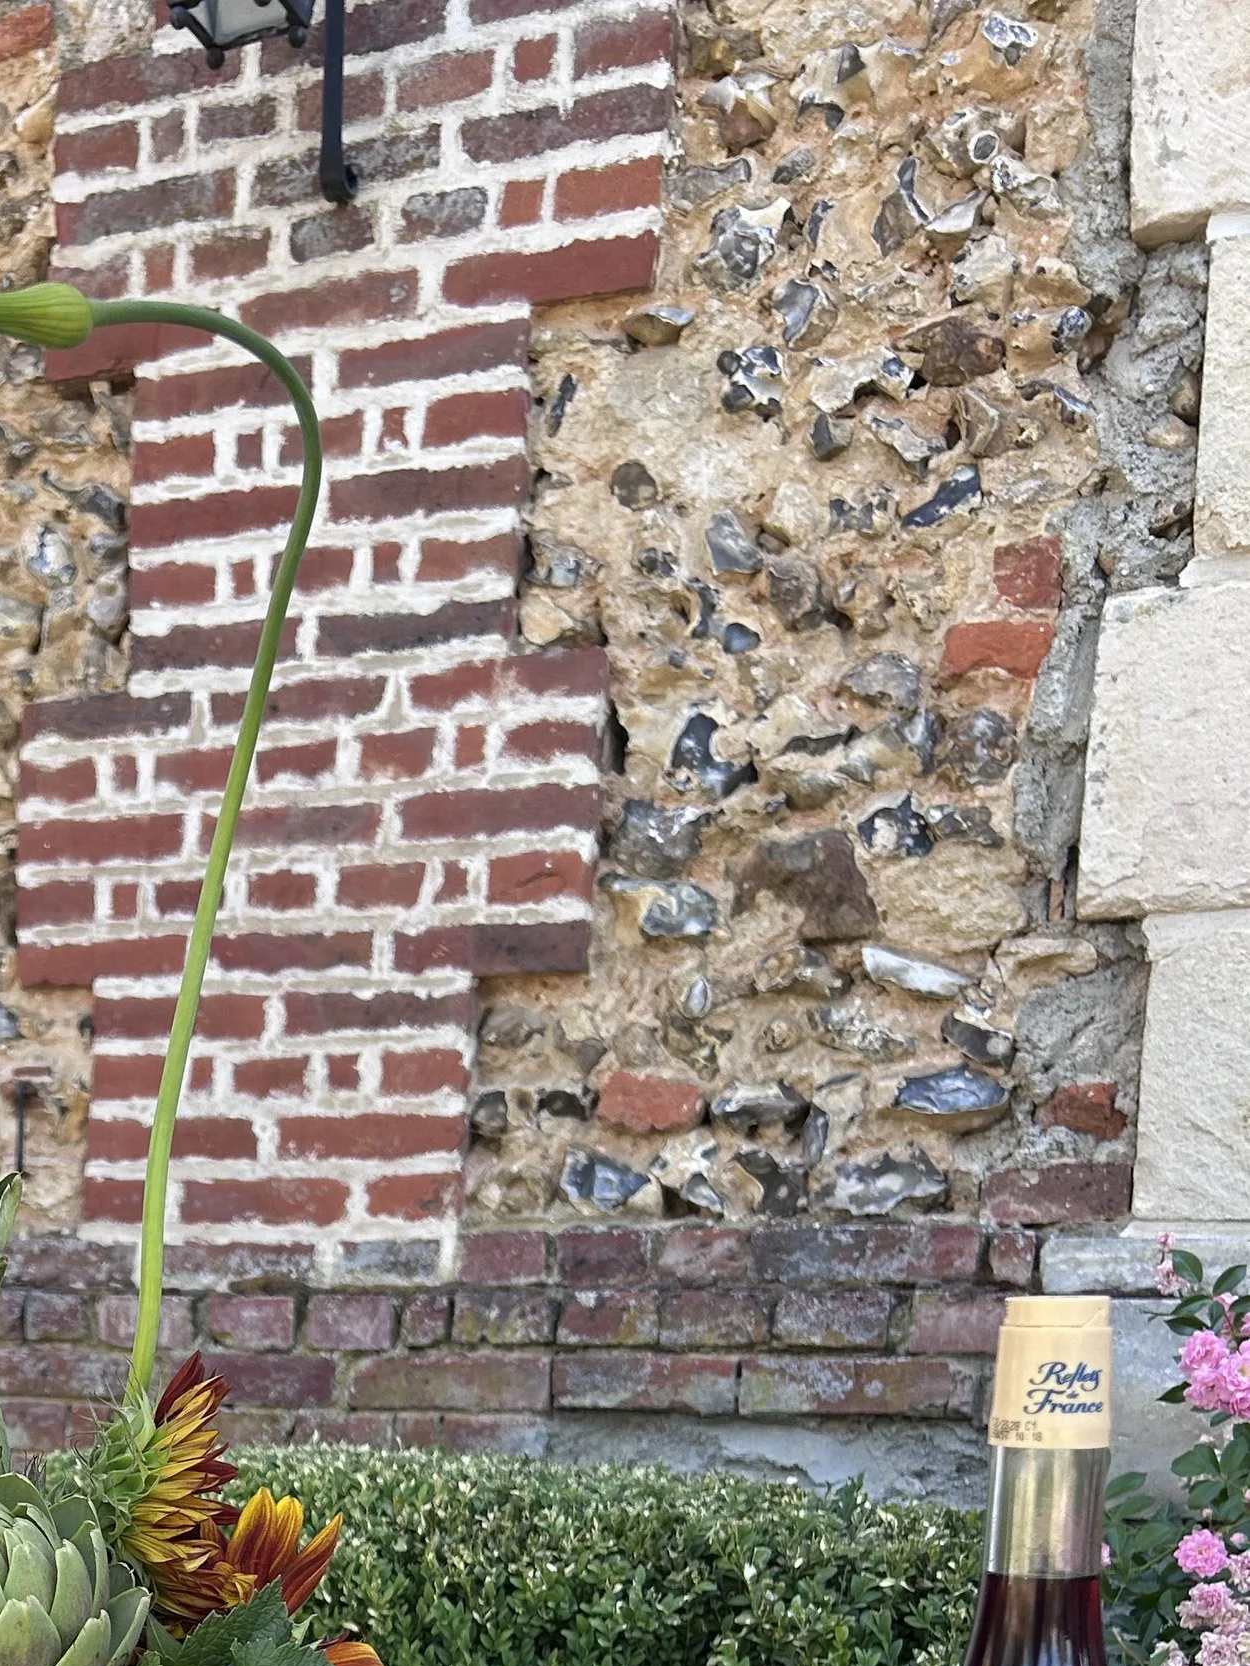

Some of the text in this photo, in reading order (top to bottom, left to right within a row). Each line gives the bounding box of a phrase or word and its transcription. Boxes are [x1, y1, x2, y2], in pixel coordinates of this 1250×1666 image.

[1029, 1361, 1103, 1392] Reflets
[1023, 1388, 1103, 1415] France
[1066, 1391, 1078, 1399] de
